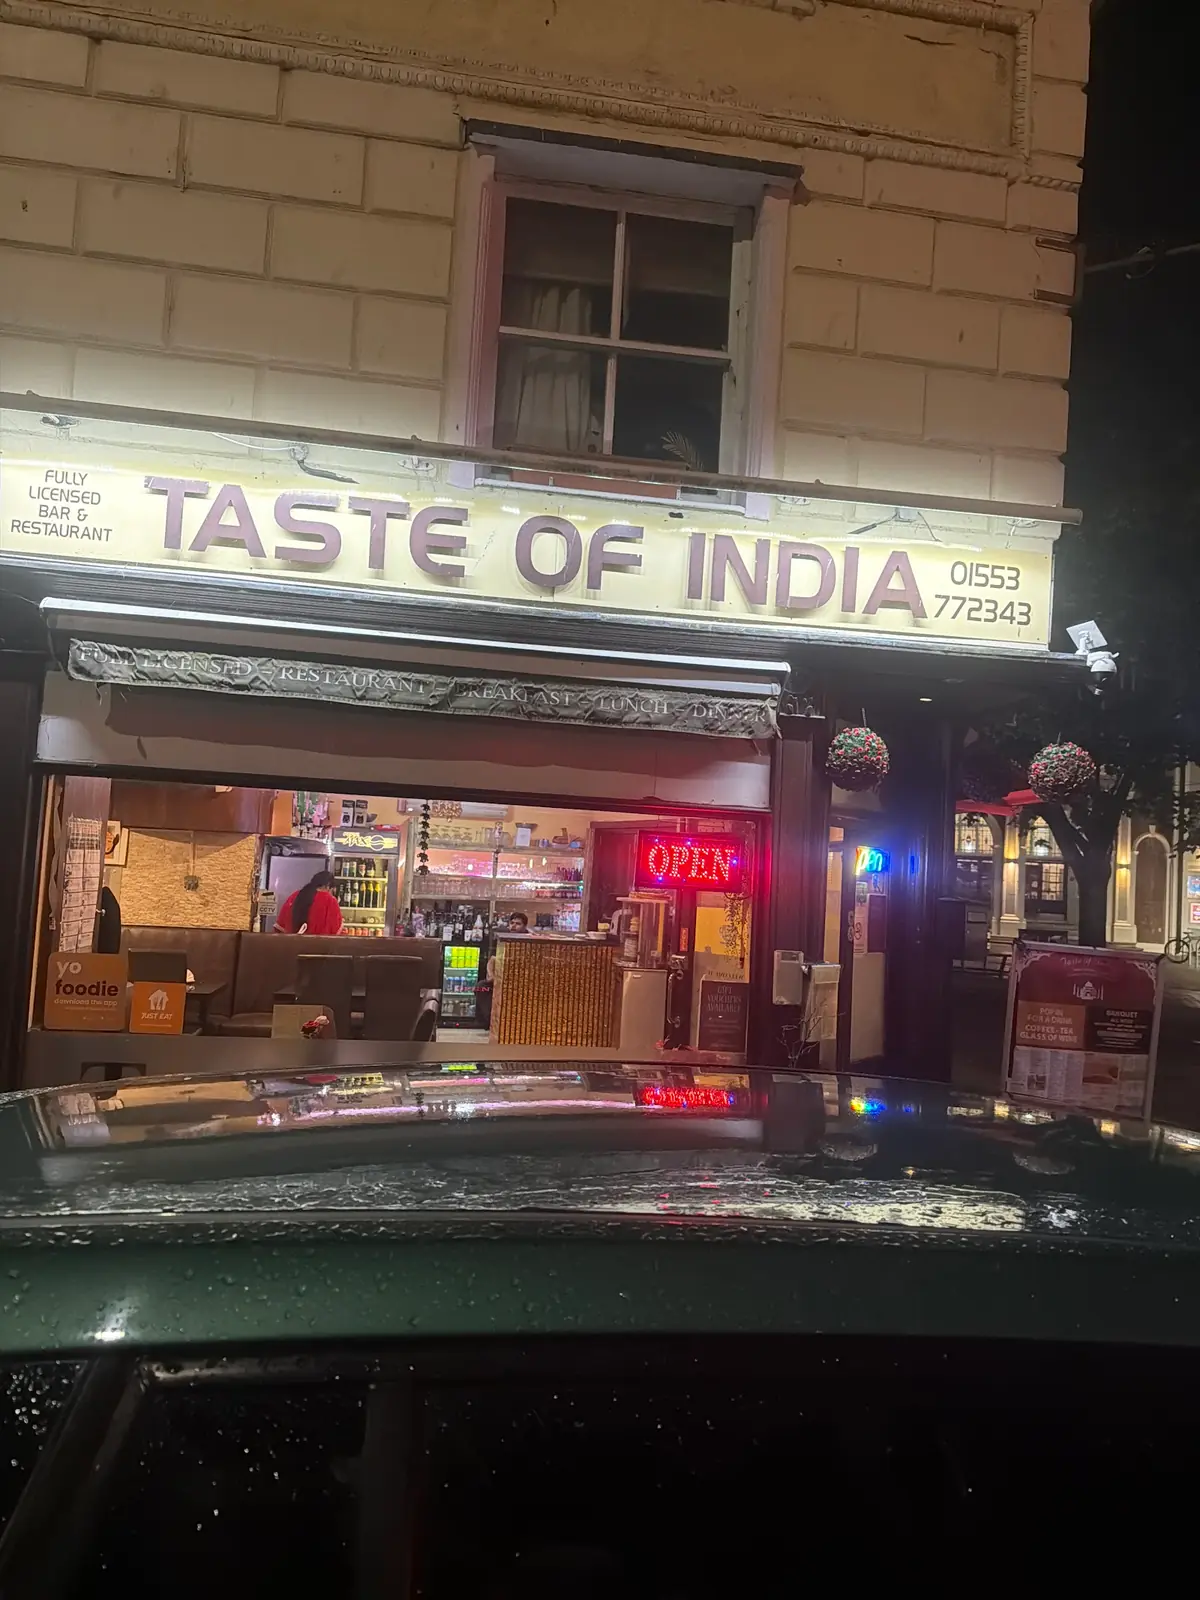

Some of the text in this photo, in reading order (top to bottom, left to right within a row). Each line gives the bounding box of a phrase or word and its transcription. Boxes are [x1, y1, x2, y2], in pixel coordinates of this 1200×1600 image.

[45, 469, 88, 486] FULLY
[28, 485, 102, 506] LICENSED
[38, 504, 89, 522] BAR &
[10, 519, 113, 542] RESTAURANT
[143, 475, 929, 620] TASTE OF INDIA
[950, 560, 1021, 591] 01553
[933, 593, 1033, 627] 772343
[143, 653, 252, 676] LICENSED
[279, 657, 427, 694] RESTAURANT
[455, 682, 573, 706] BREAKFAST
[598, 697, 669, 714] LUNCH
[648, 843, 735, 881] OPEN
[855, 849, 884, 876] pen
[259, 906, 277, 914] CCTV
[56, 961, 82, 979] yo
[55, 979, 119, 997] foodie
[103, 1000, 118, 1008] app
[141, 1012, 159, 1020] JUST
